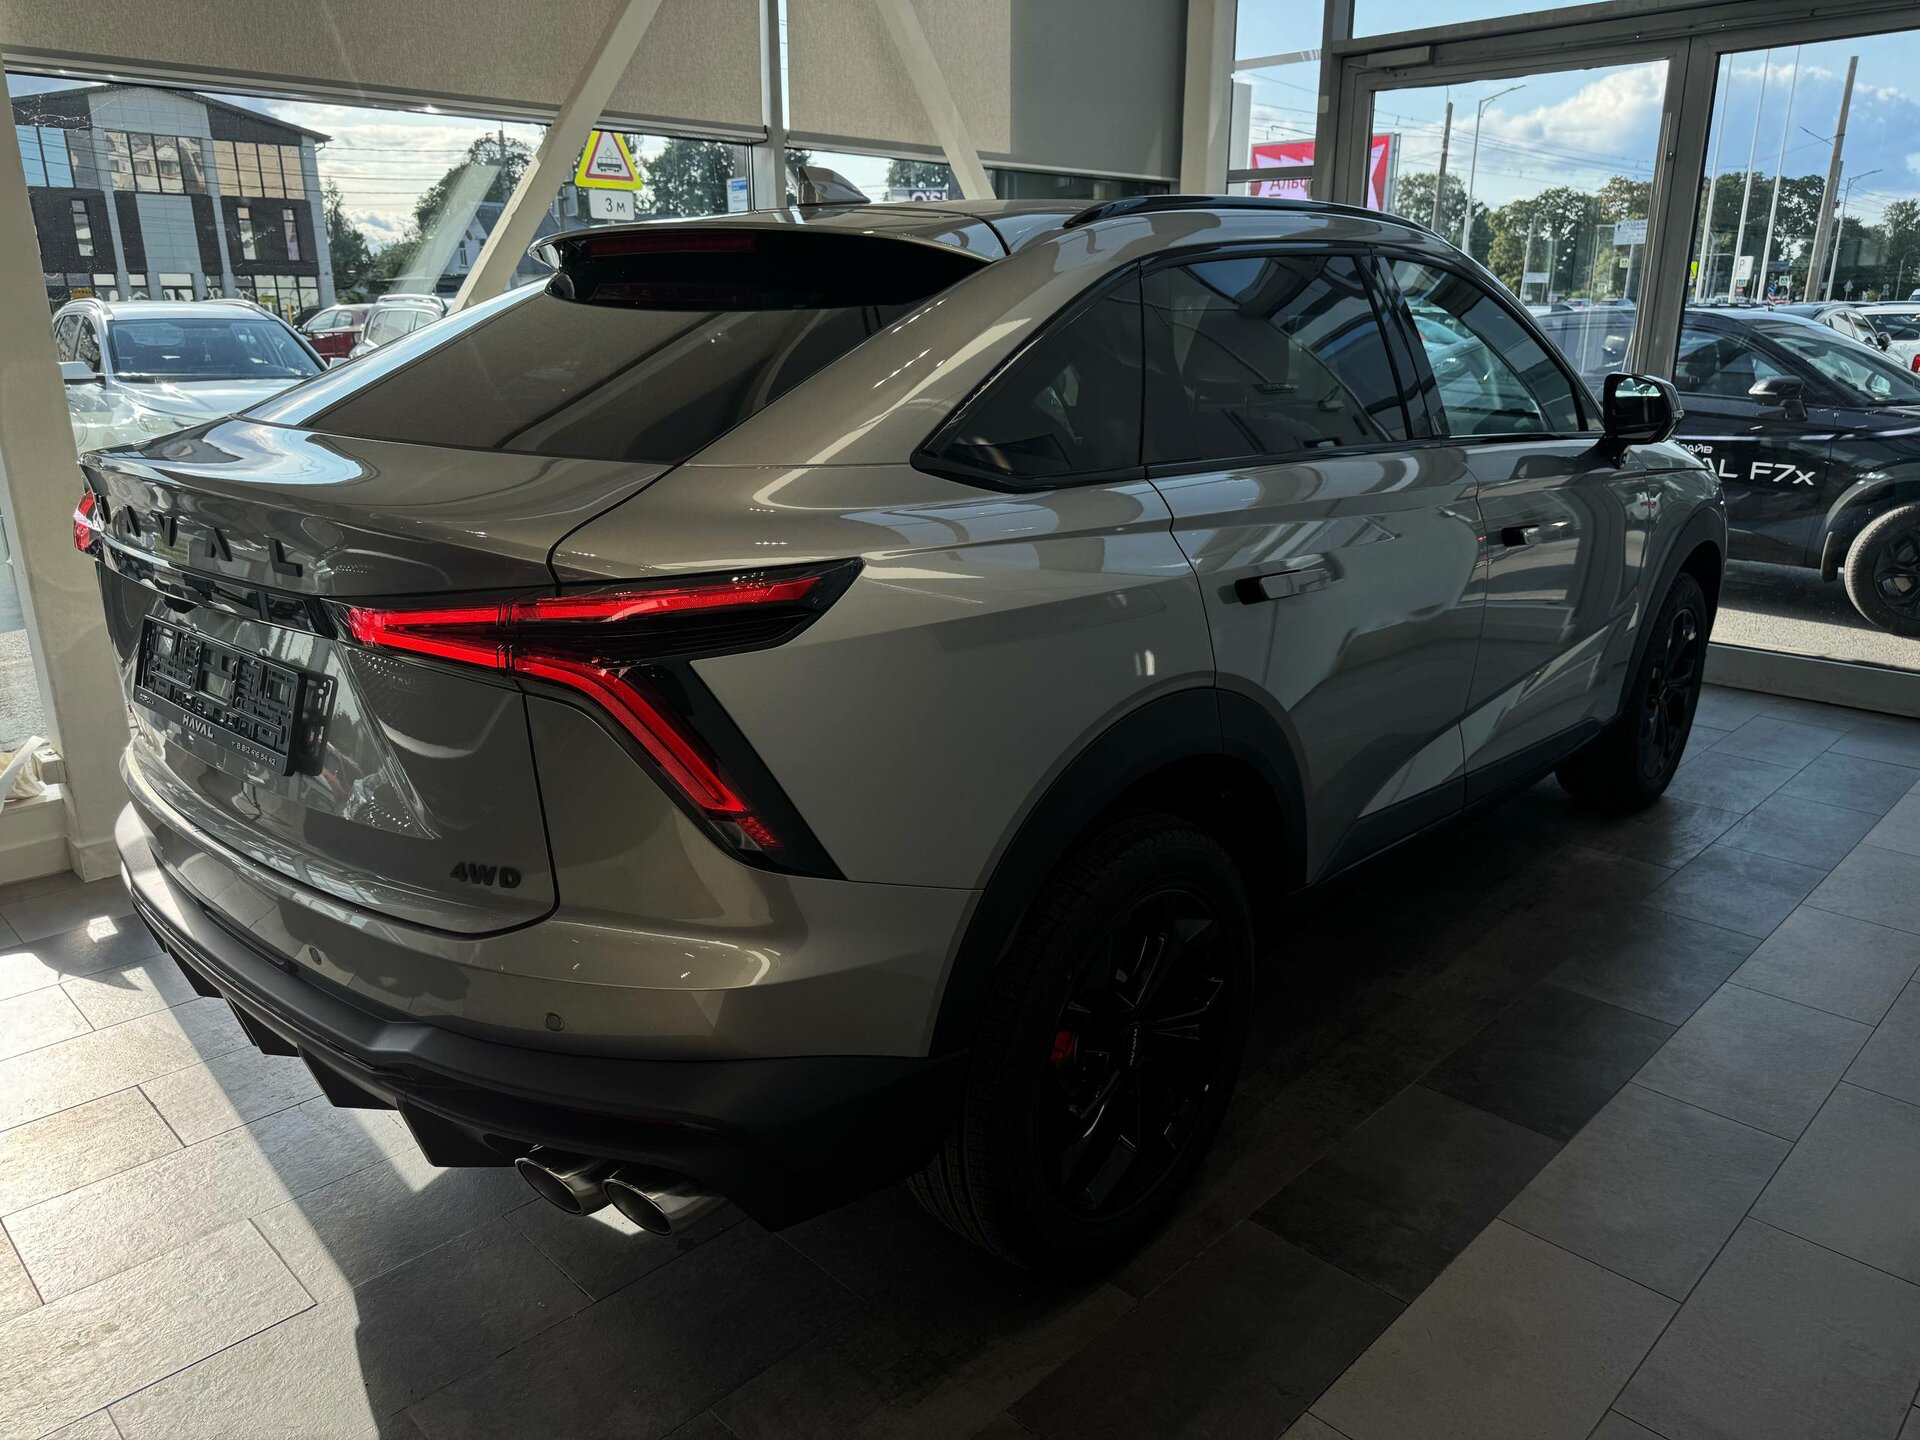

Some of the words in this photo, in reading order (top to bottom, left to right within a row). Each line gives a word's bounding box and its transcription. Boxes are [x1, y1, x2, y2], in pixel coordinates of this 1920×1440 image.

[605, 197, 613, 212] 3
[95, 494, 303, 577] HAVAL
[182, 713, 214, 739] HAVAL
[450, 862, 521, 888] 4WD
